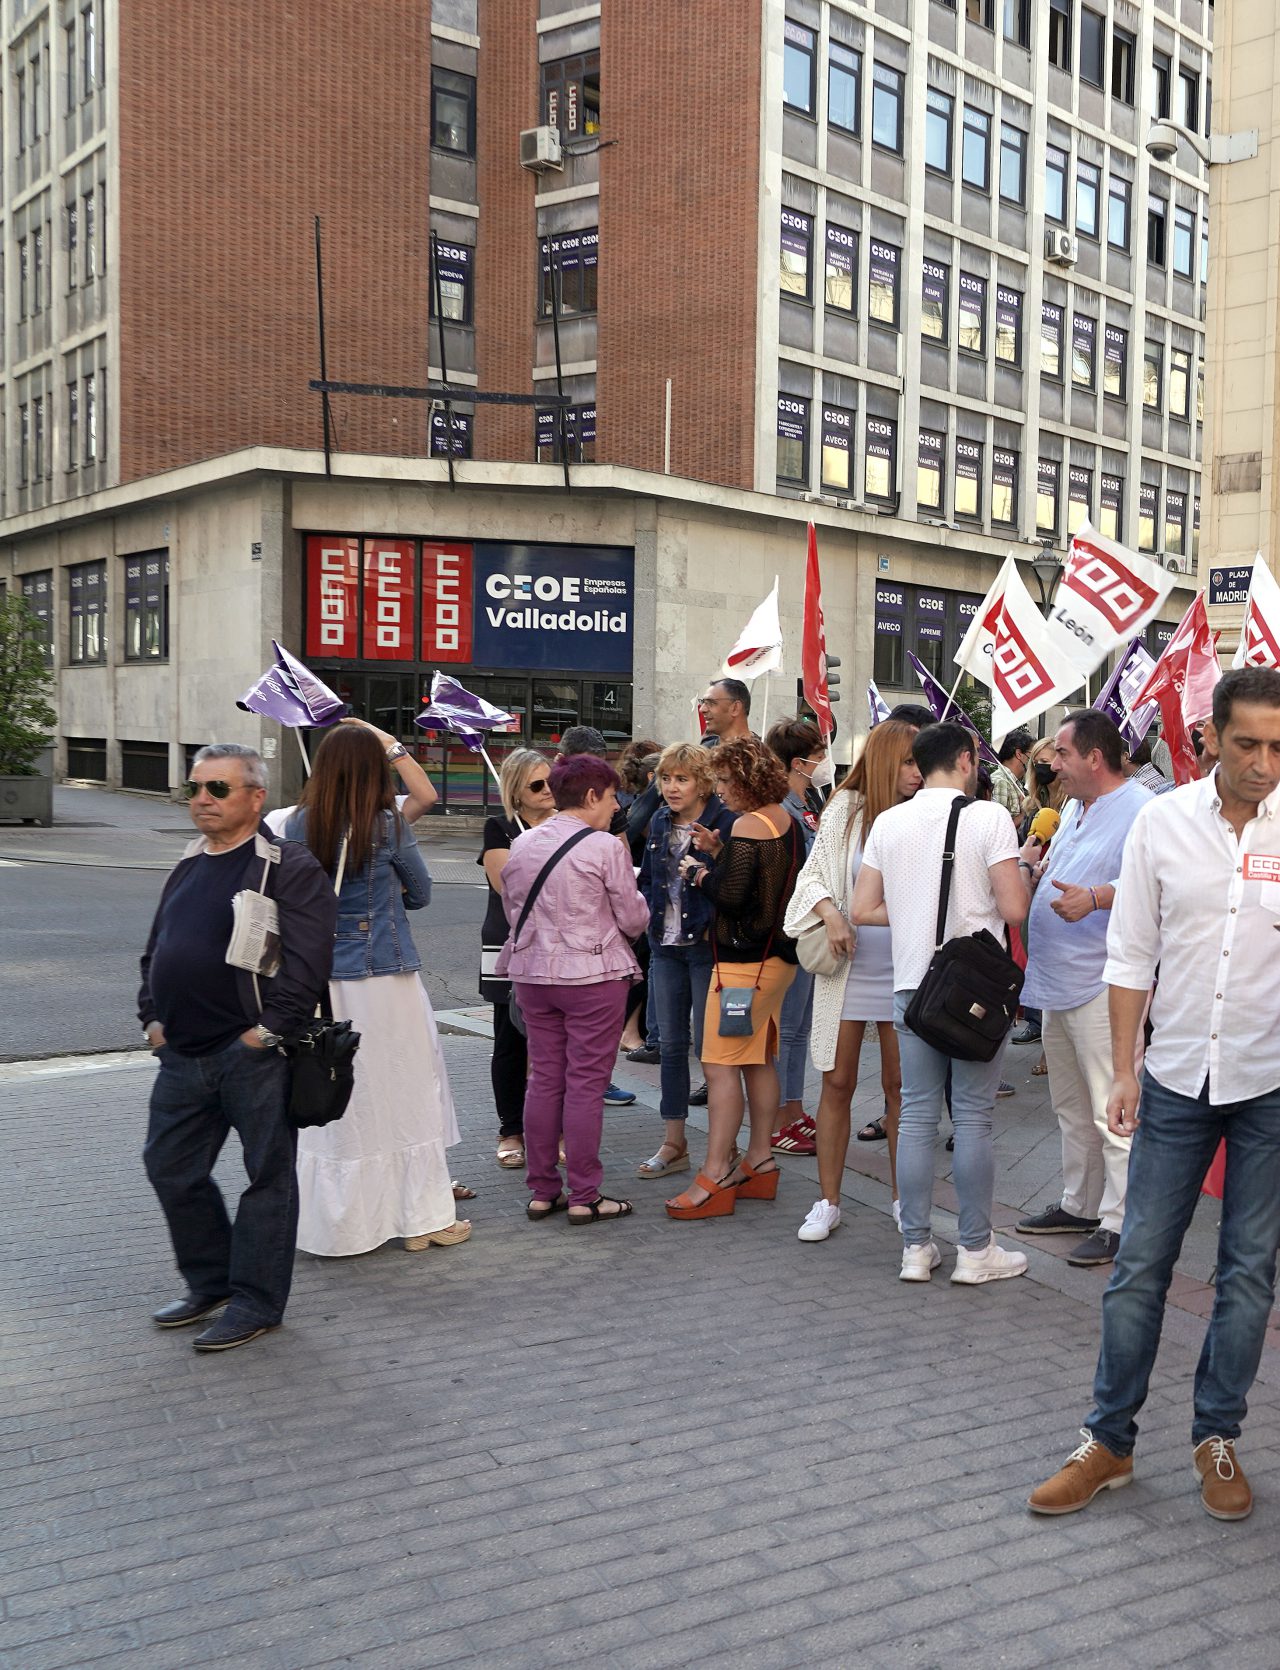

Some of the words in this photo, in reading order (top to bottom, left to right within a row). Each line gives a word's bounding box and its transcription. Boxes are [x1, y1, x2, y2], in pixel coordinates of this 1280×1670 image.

[549, 91, 557, 129] CCO
[781, 212, 808, 232] CEOE
[828, 229, 854, 247] CEOE
[871, 244, 896, 262] CEOE
[960, 277, 982, 293] CEOE
[997, 290, 1018, 306] CEOE
[1074, 317, 1093, 333] CEOE
[1105, 329, 1124, 344] CEOE
[778, 399, 805, 416] CEOE
[824, 411, 850, 427] CEOE
[867, 421, 892, 437] CEOE
[825, 434, 848, 447] AVECO
[868, 444, 890, 456] AVEMA
[957, 444, 979, 458] CEOE
[994, 453, 1015, 467] CEOE
[1070, 471, 1089, 484] CEOE
[1101, 479, 1120, 491] CEOE
[584, 577, 626, 587] Empresas
[1228, 570, 1250, 579] PLAZA
[485, 573, 581, 603] CEOE
[584, 585, 627, 595] Españolas
[320, 549, 344, 646] CCOO
[377, 551, 402, 647] CCOO
[436, 554, 460, 650] CCOO
[876, 591, 903, 605] CEOE
[919, 597, 944, 611] CEOE
[1215, 590, 1248, 603] MADRID
[485, 606, 627, 633] Valladolid
[877, 622, 901, 632] AVECO
[604, 690, 616, 705] 4
